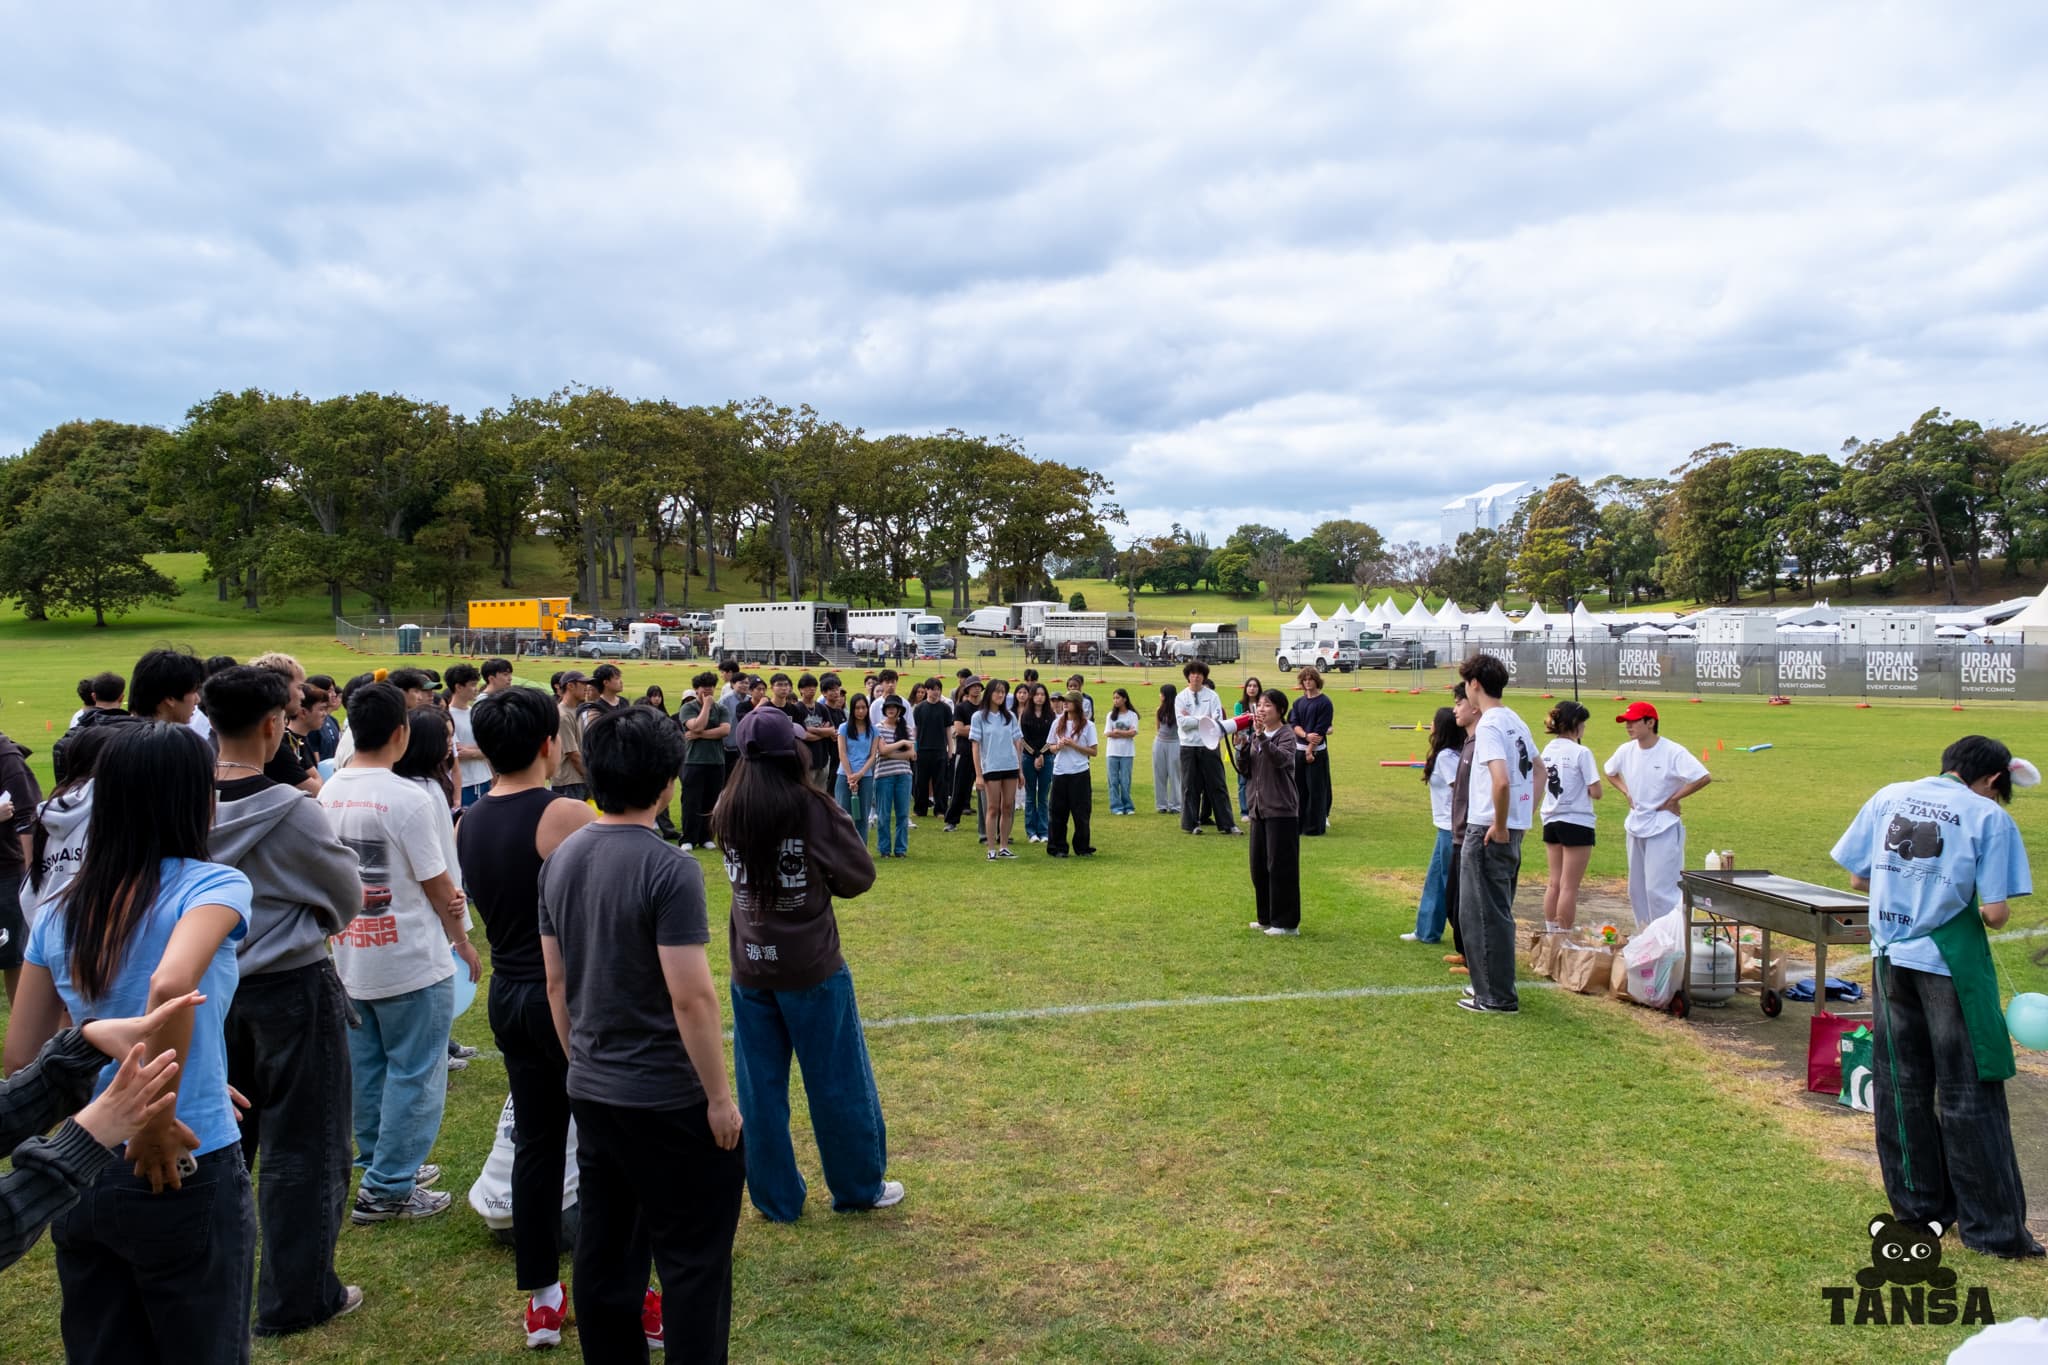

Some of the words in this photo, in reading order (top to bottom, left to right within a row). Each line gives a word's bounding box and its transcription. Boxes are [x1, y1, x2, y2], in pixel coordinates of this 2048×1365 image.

[1546, 649, 1583, 662] URBAN
[1619, 649, 1658, 663] URBAN
[1696, 650, 1737, 665] URBAN
[1778, 651, 1822, 665] URBAN
[1866, 651, 1913, 666] URBAN
[1961, 652, 2011, 668] URBAN
[1546, 662, 1586, 676] EVENTS
[1619, 662, 1661, 677] EVENTS
[1696, 664, 1741, 679] EVENTS
[1778, 665, 1826, 680] EVENTS
[1866, 666, 1919, 681] EVENTS
[1961, 667, 2016, 684] EVENTS
[1908, 804, 1961, 826] TANSA
[346, 915, 397, 932] GER
[1879, 910, 1914, 929] INTER
[329, 929, 399, 949] YTONA
